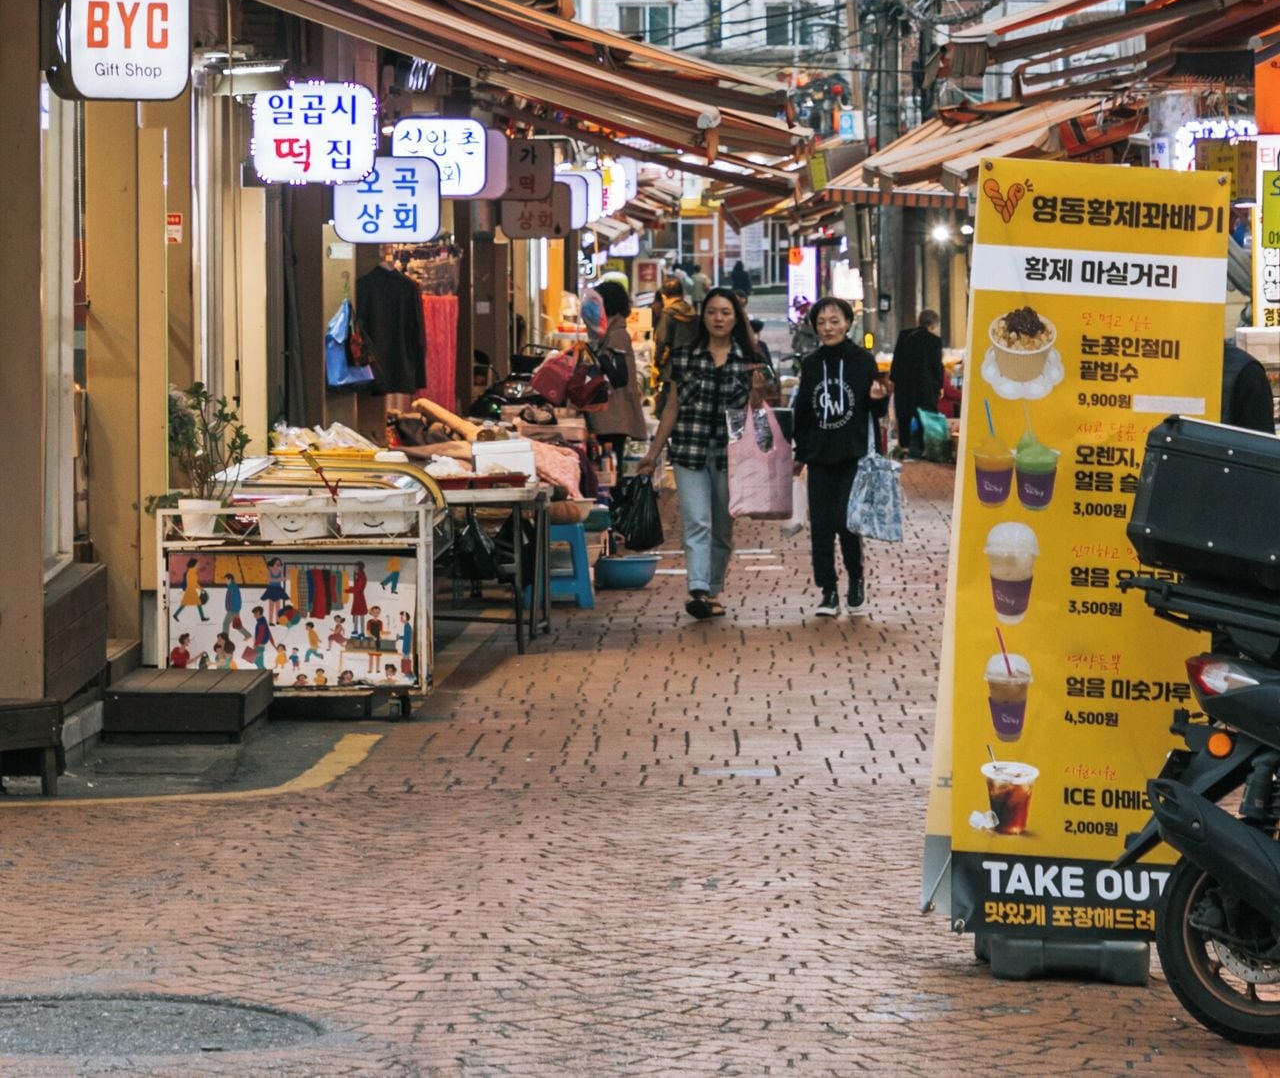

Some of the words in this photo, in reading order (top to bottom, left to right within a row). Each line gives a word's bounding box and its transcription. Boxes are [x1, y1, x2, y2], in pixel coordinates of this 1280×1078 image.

[86, 0, 169, 50] BYC
[95, 61, 121, 78] Gift
[125, 61, 162, 80] Shop
[268, 94, 358, 126] 일곱시
[399, 128, 480, 156] 신앙촌
[1032, 195, 1223, 234] 영동황제꽈배기
[1025, 256, 1072, 283] 황제
[1081, 259, 1177, 289] 마실거리
[1081, 334, 1180, 360] 눈꽃인절미
[1079, 360, 1139, 383] 팥빙수
[1078, 392, 1132, 409] 9,900원
[1075, 446, 1140, 470] 오렌지,
[1074, 471, 1112, 492] 얼음
[1073, 502, 1126, 519] 3,000원
[1070, 566, 1109, 588] 얼음
[1068, 600, 1122, 616] 3,500원
[1066, 677, 1106, 698] 얼음
[1111, 679, 1192, 703] 미숫가루
[1064, 710, 1119, 727] 4,500원
[1063, 787, 1095, 806] ICE
[1064, 820, 1118, 837] 2,000원
[982, 861, 1084, 899] TAKE
[984, 902, 1045, 927] 맛있게
